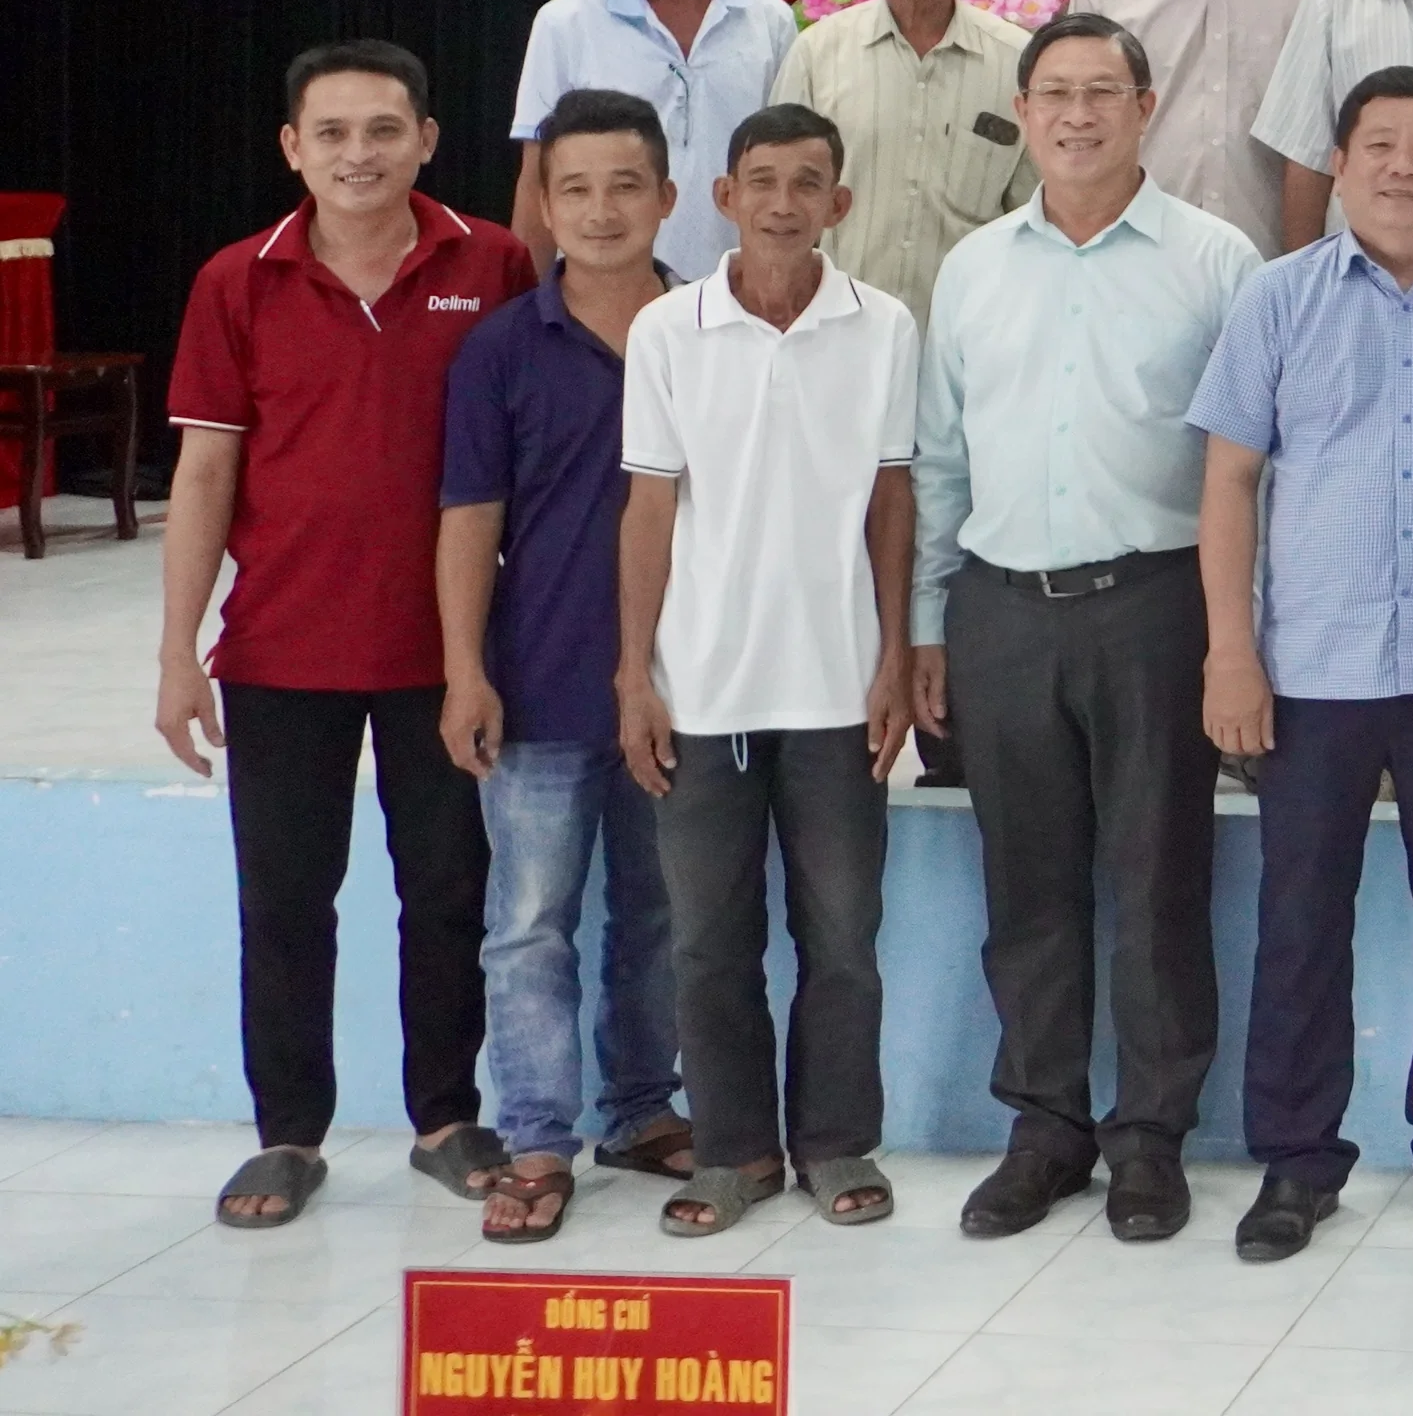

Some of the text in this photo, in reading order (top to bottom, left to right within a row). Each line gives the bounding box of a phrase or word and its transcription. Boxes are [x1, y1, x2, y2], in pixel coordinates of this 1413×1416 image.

[419, 1336, 775, 1404] NGUYỄN HUY HOÀNG
